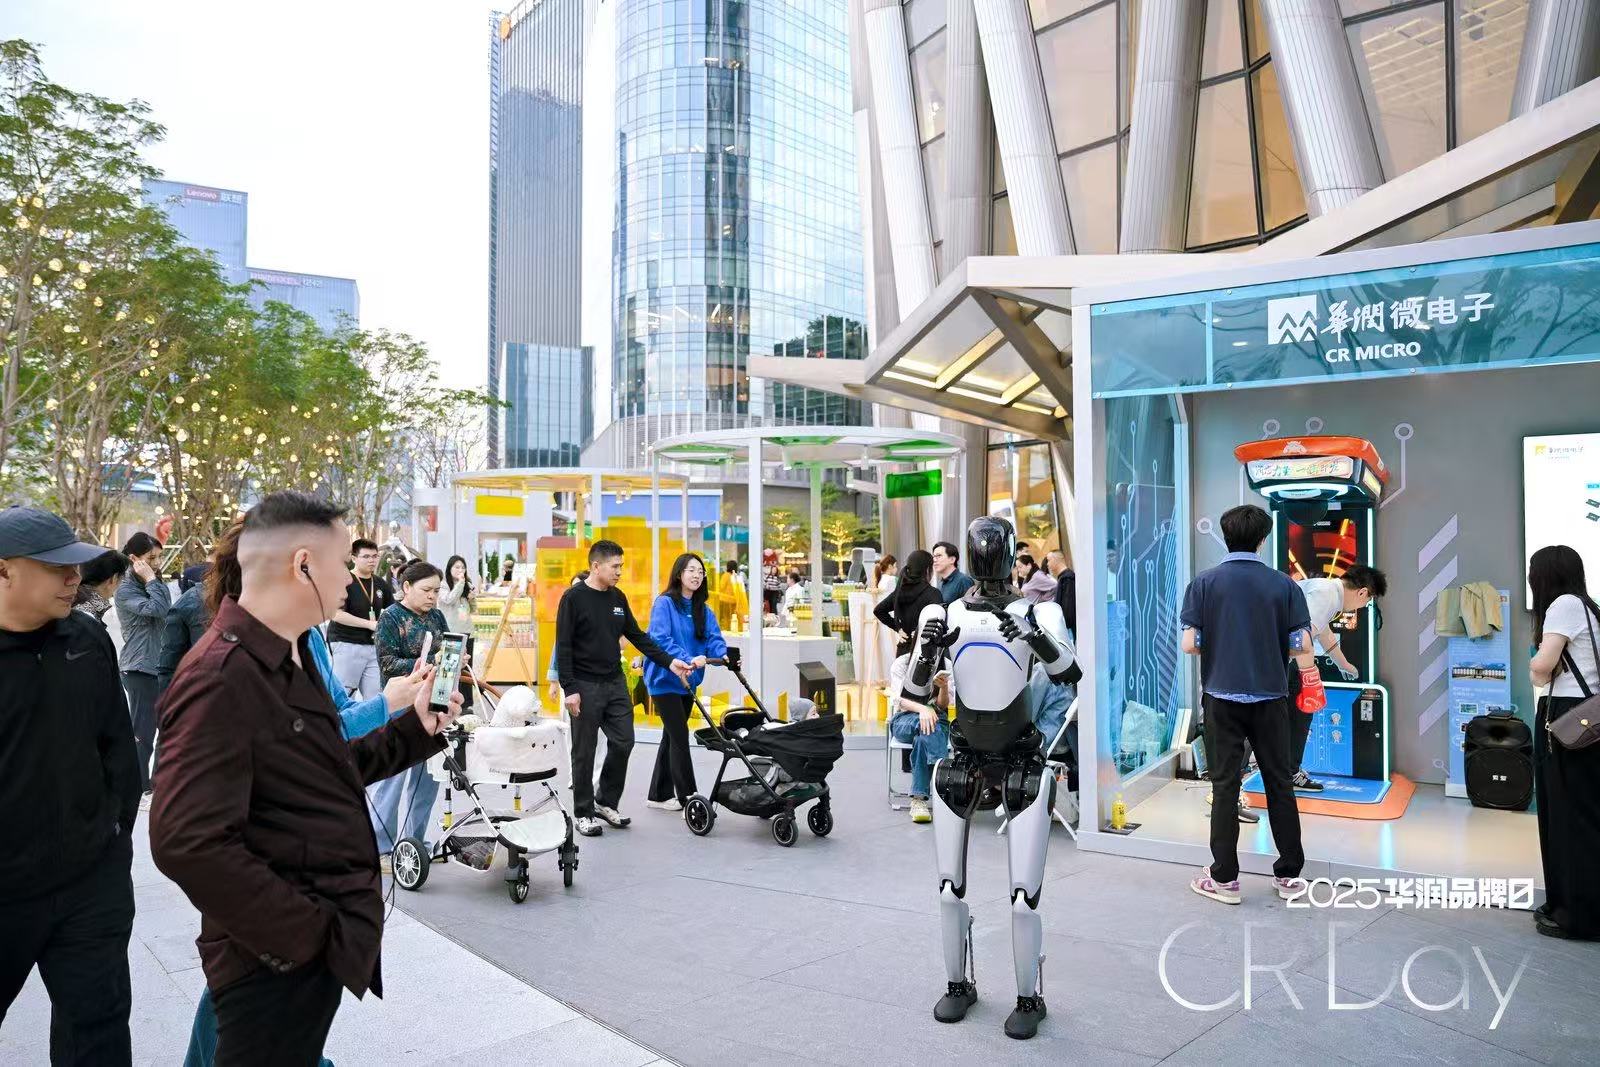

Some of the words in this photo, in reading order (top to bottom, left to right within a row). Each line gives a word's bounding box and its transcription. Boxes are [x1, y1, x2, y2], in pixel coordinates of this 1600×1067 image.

[187, 188, 217, 200] Lenovo
[1325, 348, 1351, 363] CR
[1355, 341, 1421, 361] MICRO
